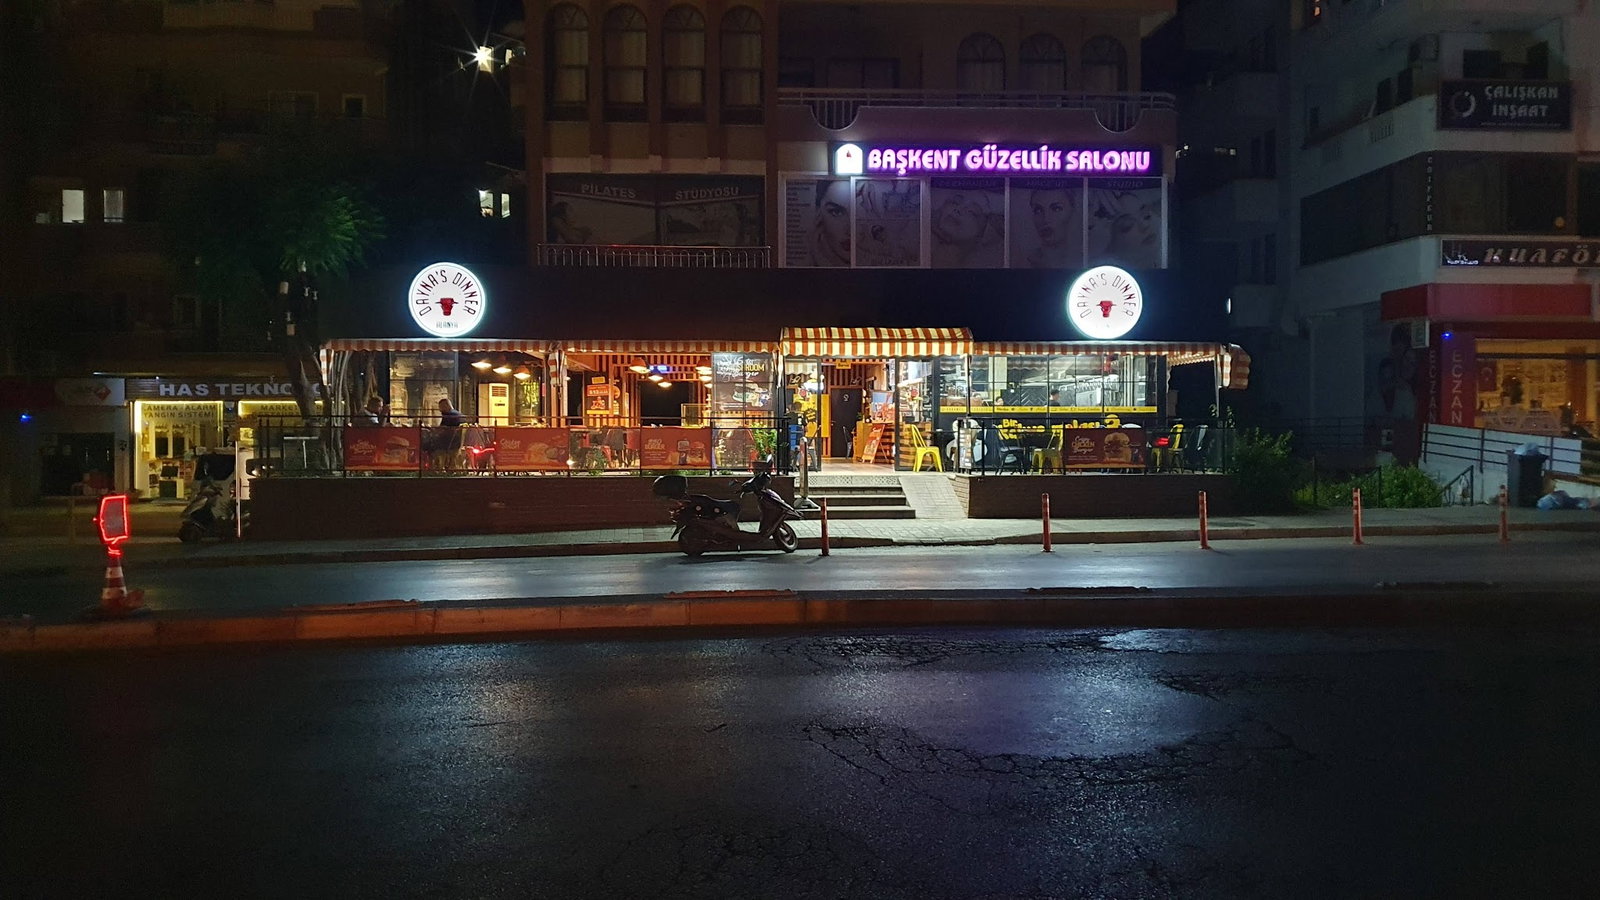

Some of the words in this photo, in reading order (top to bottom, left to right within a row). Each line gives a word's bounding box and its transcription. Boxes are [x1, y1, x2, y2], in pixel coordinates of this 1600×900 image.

[869, 148, 962, 174] BAŞKENT
[966, 144, 1062, 171] GÜZELLİK
[1065, 149, 1151, 171] SALONU
[1483, 244, 1600, 265] KUAFÖ
[415, 269, 448, 317] DAYNA'S
[452, 272, 479, 316] DINNER
[1077, 272, 1108, 319] DAYNA'S
[1111, 275, 1137, 318] DINNER
[159, 383, 209, 396] HAS
[185, 404, 217, 412] ALARM
